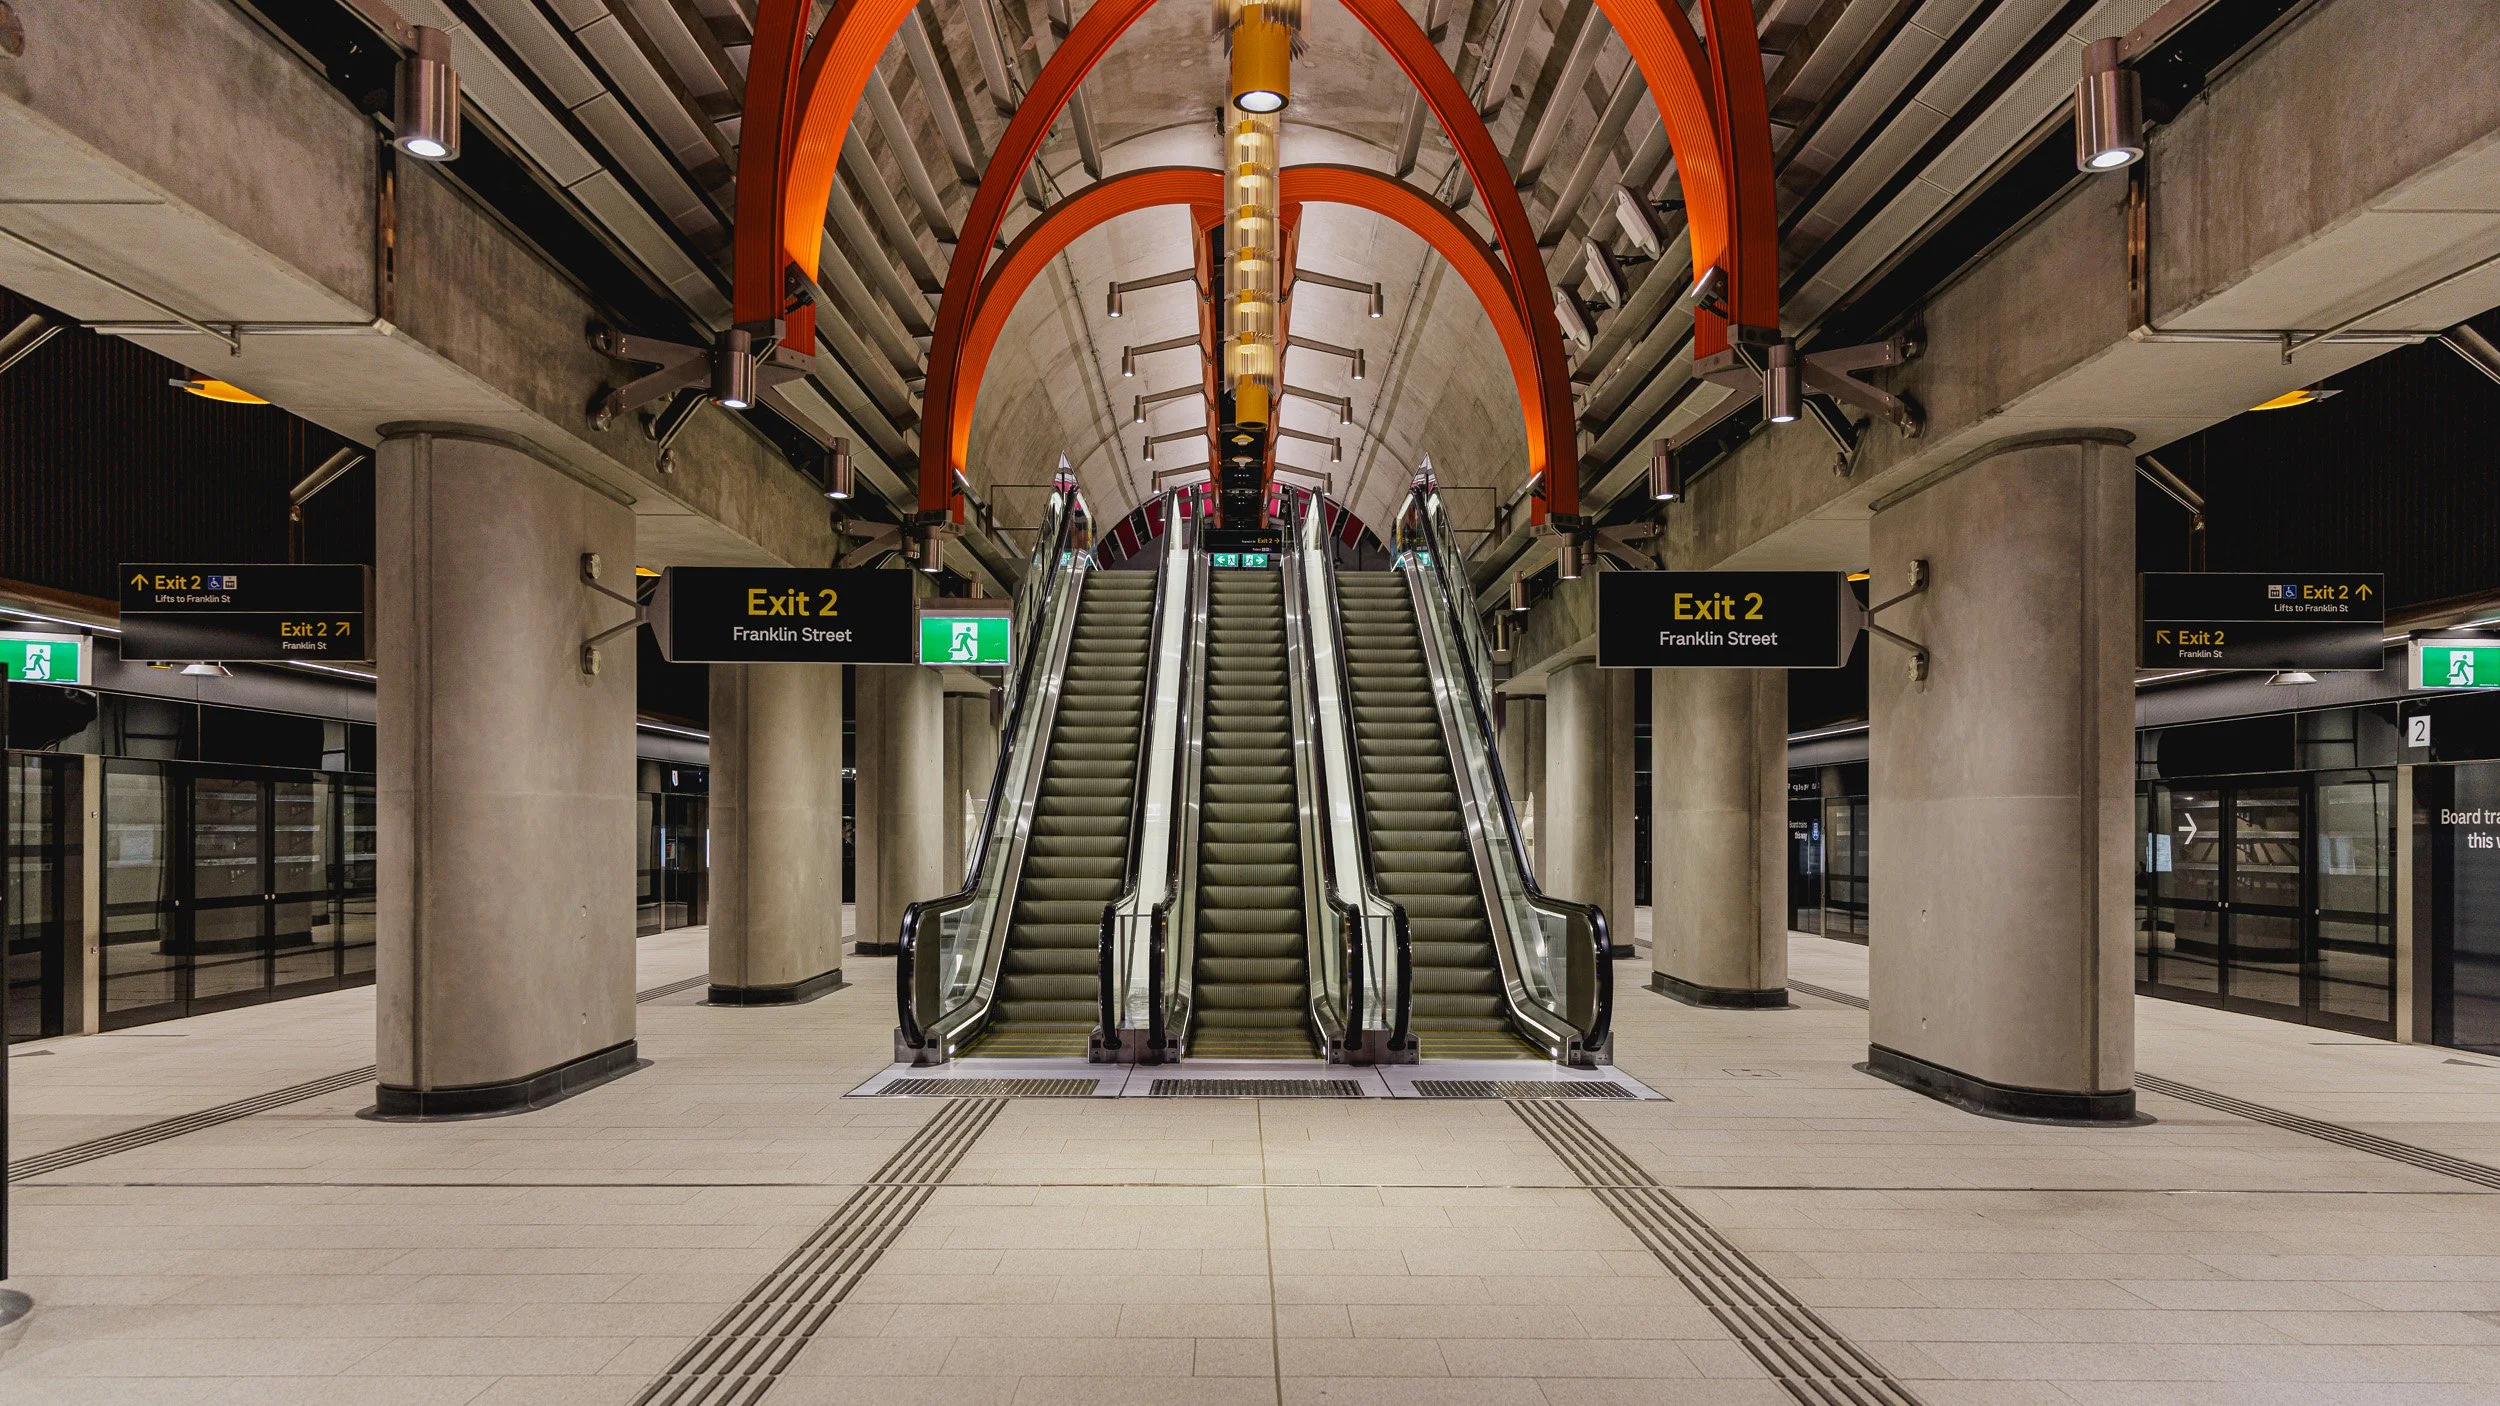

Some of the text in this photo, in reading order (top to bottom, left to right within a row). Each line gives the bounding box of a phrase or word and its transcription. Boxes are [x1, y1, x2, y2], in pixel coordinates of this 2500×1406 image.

[155, 575, 201, 590] Exit 2
[155, 594, 231, 603] Lifts to Franklin St
[2303, 584, 2349, 600] Exit 2
[747, 588, 838, 617] Exit 2
[1674, 592, 1764, 621] Exit 2
[2274, 603, 2349, 612] Lifts to Franklin St
[281, 622, 327, 637] Exit 2
[733, 626, 853, 642] Franklin Street
[2179, 630, 2225, 645] Exit 2
[282, 641, 327, 650] Franklin St
[1660, 630, 1778, 646] Franklin Street
[2179, 649, 2223, 658] Franklin St
[2415, 720, 2426, 742] 2
[2441, 808, 2481, 825] Board
[2467, 831, 2494, 849] this
